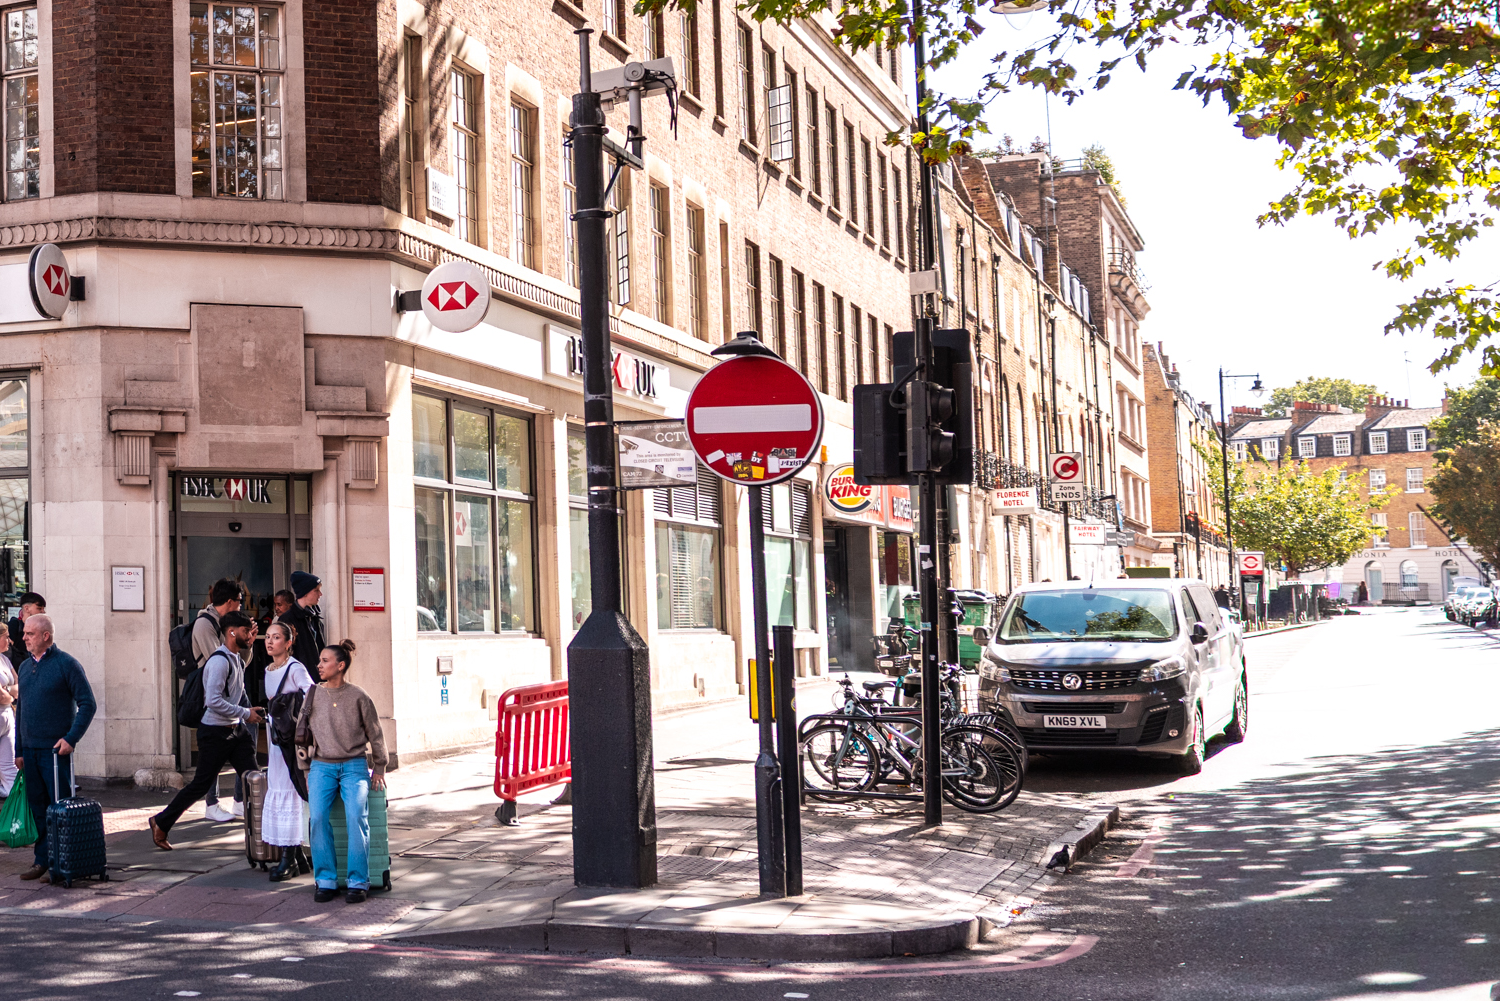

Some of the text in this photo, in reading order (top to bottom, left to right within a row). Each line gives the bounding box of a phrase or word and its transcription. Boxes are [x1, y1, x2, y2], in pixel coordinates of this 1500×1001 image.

[634, 359, 656, 398] UK
[831, 476, 856, 487] BUR
[247, 479, 273, 504] UK
[830, 485, 872, 499] KING
[997, 490, 1030, 499] FLORENCE
[1048, 716, 1076, 726] KN69
